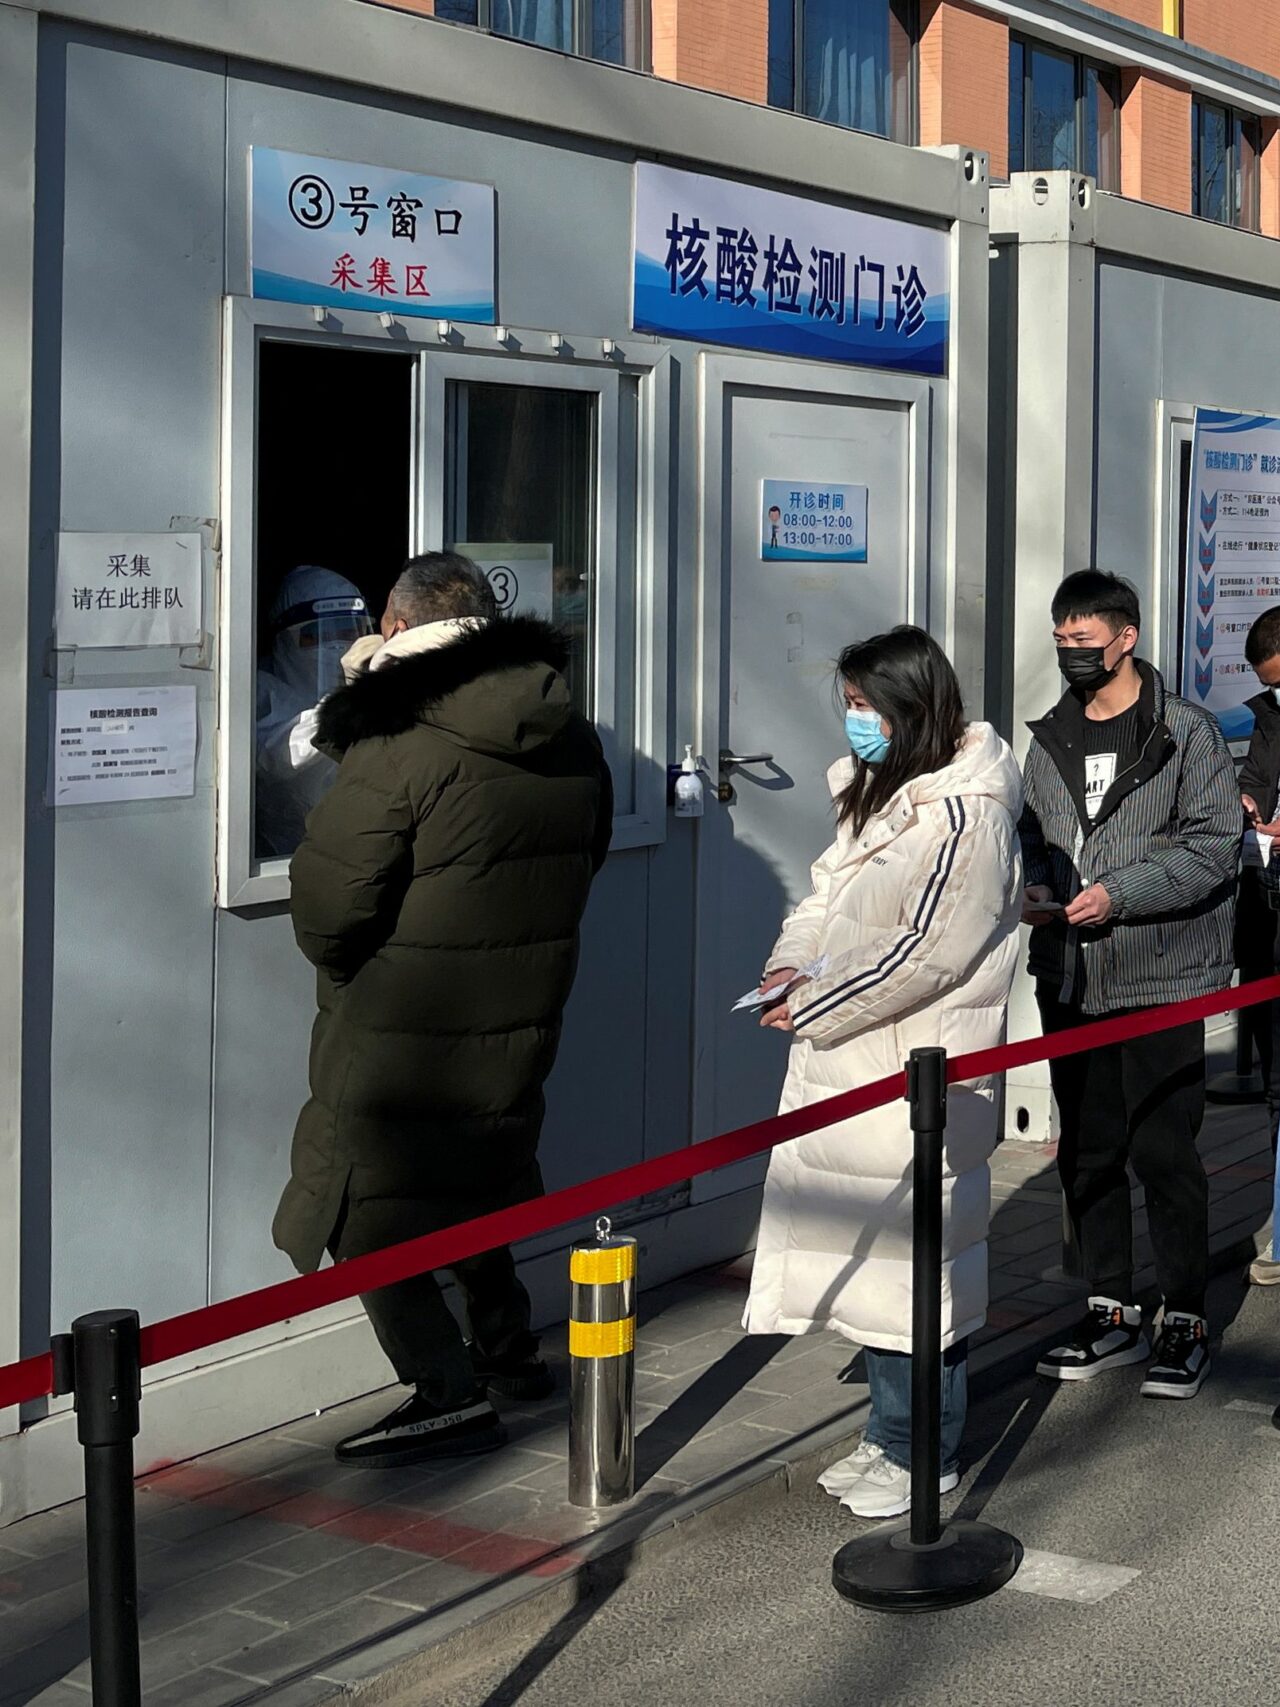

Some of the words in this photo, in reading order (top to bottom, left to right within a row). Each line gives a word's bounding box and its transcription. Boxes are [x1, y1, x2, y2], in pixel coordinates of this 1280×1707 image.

[330, 253, 432, 297] 采集区
[664, 212, 928, 339] 核酸检测门诊
[789, 491, 845, 512] 开诊时间
[783, 513, 853, 528] 08:00-12:00
[783, 532, 853, 546] 13:00-17:00
[106, 554, 152, 578] 采集
[71, 586, 184, 611] 请在此排队
